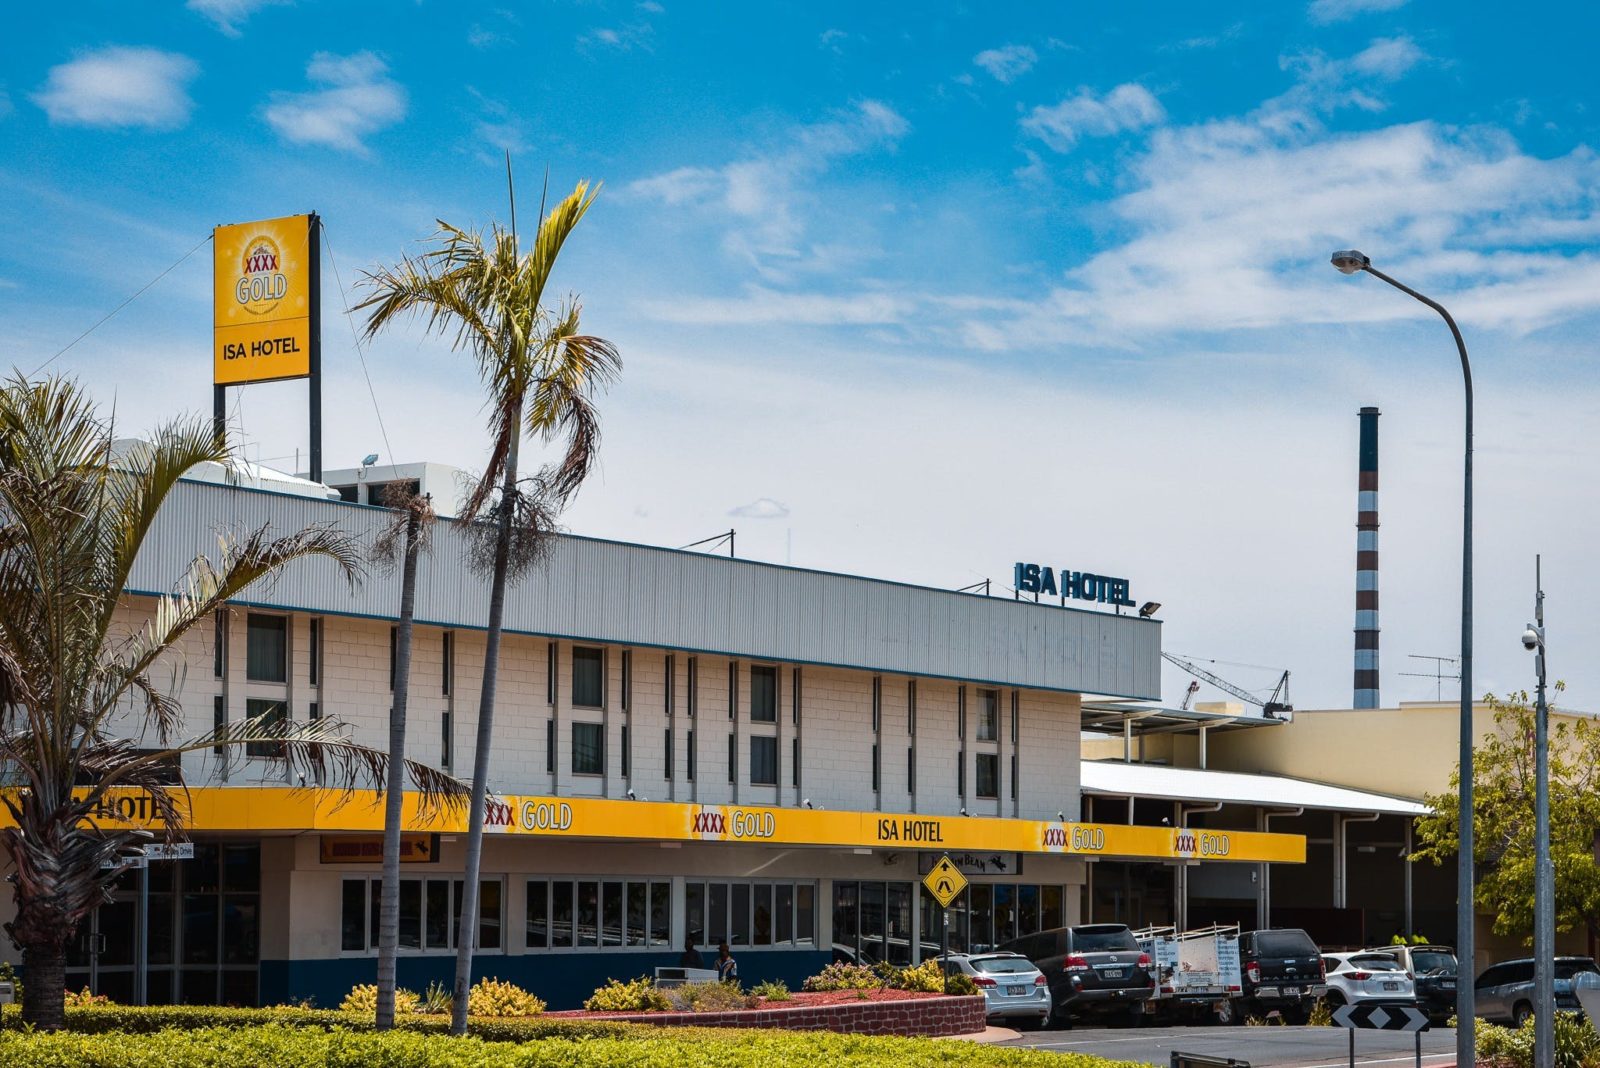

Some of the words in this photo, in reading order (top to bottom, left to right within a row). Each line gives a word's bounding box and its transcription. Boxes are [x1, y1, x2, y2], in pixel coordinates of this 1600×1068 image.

[244, 254, 278, 275] XXXX
[236, 274, 287, 304] GOLD
[223, 342, 247, 360] ISA
[251, 337, 300, 357] HOTEL
[1014, 562, 1057, 596] ISA
[1060, 570, 1136, 607] HOTEL
[484, 803, 515, 826] XXX
[521, 800, 573, 830] GOLD
[692, 813, 727, 833] XXXX
[732, 810, 775, 838] GOLD
[878, 819, 899, 840] ISA
[903, 821, 943, 842] HOTEL
[1042, 829, 1068, 848] XXXX
[1072, 826, 1105, 850] GOLD
[1174, 835, 1198, 853] XXXX
[1200, 833, 1230, 856] GOLD
